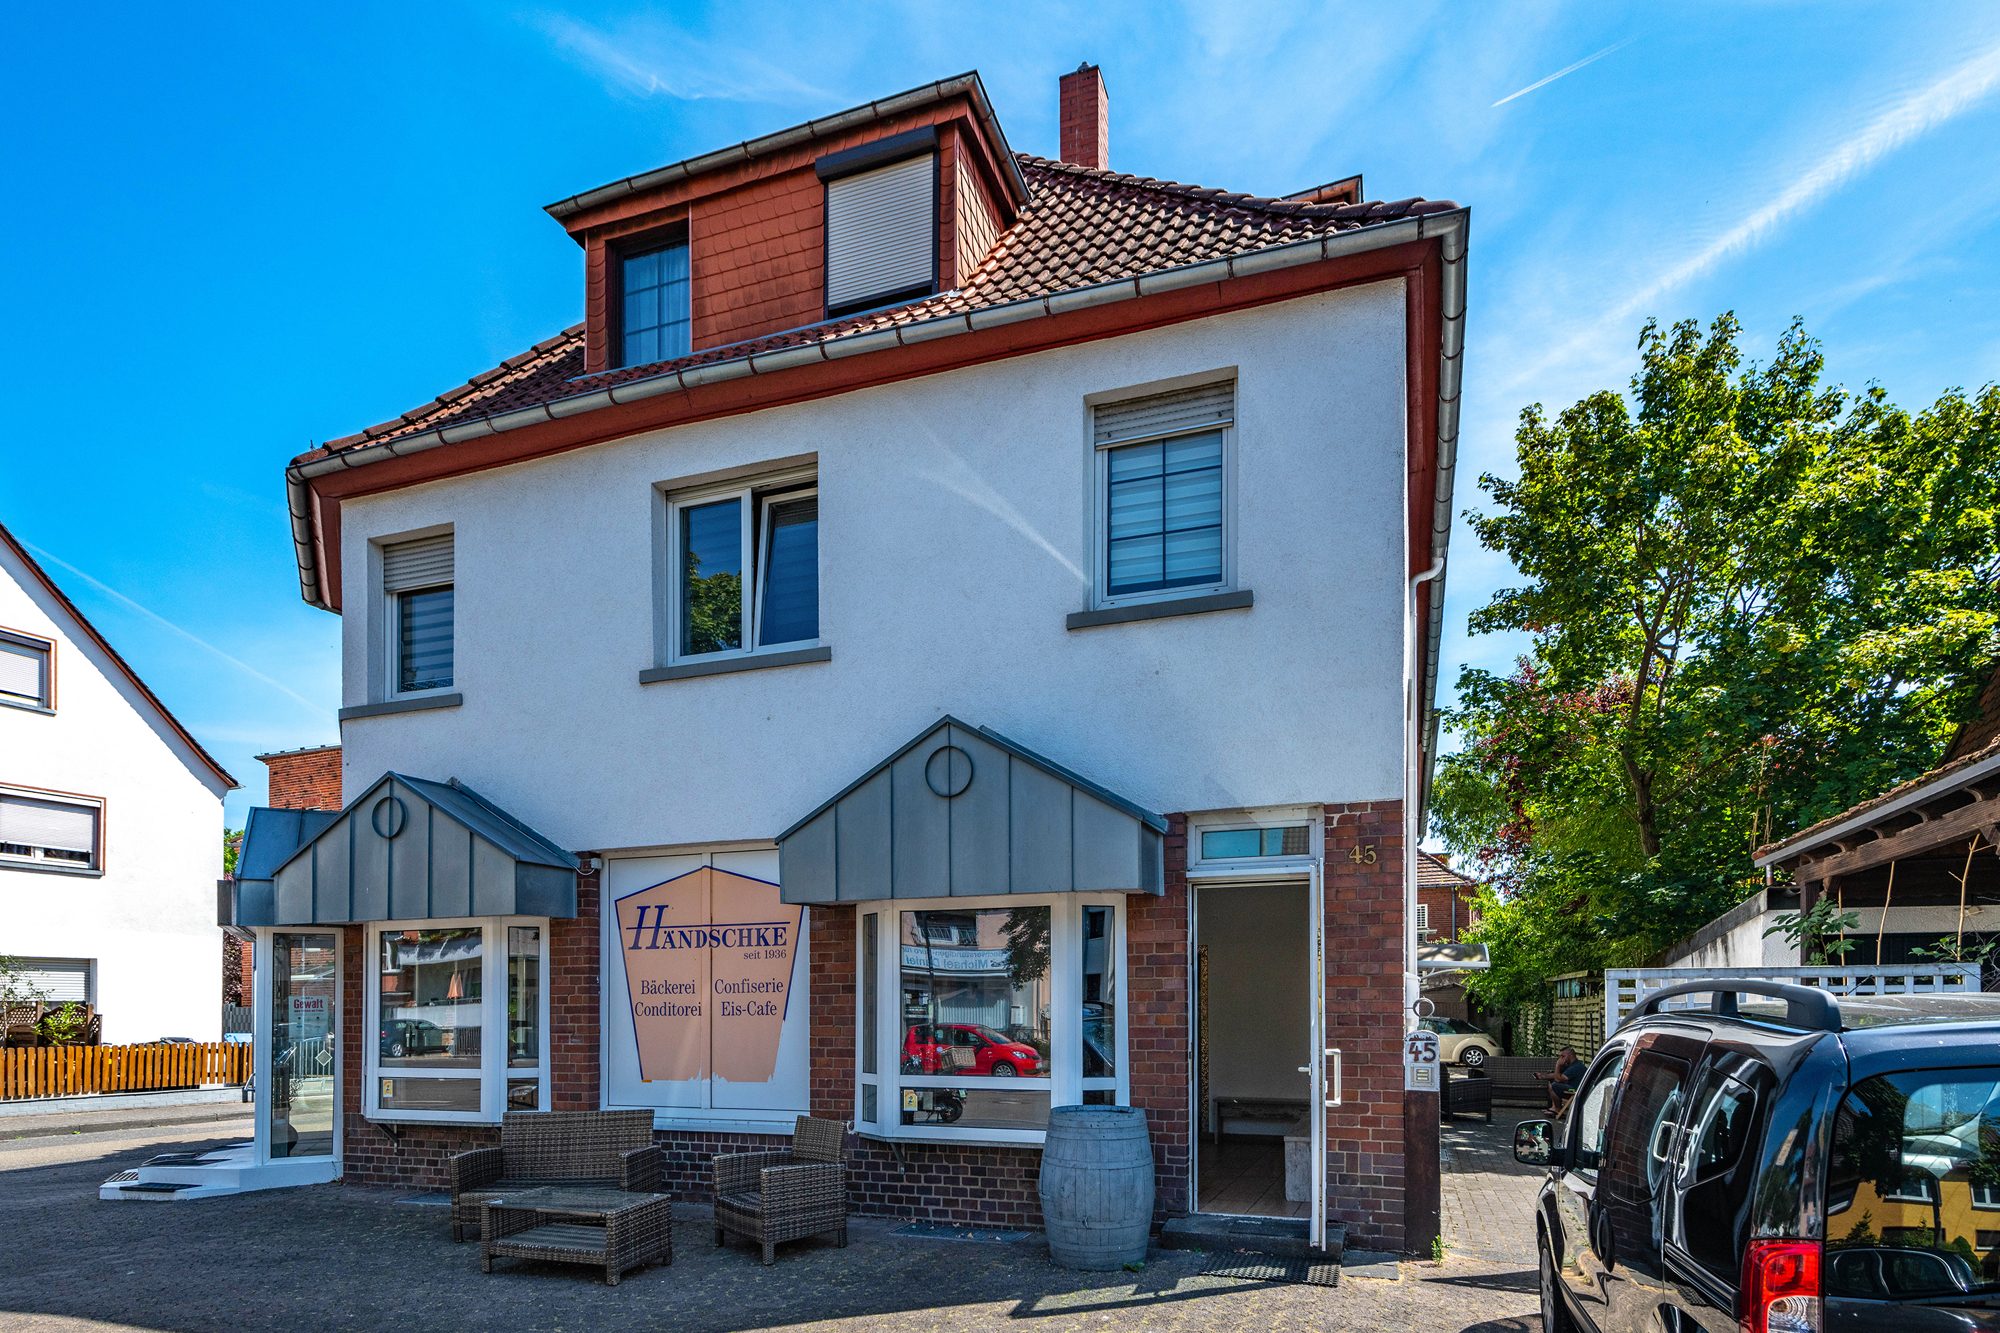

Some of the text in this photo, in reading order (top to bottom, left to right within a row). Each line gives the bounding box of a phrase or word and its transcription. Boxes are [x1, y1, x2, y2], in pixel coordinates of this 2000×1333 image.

[1348, 844, 1377, 865] 45
[627, 904, 788, 950] HÄNDSCHKE
[743, 949, 787, 960] seit 1936
[640, 979, 696, 995] Bäckerei
[714, 978, 784, 995] Confiserie
[293, 999, 324, 1009] Gewalt
[634, 1001, 702, 1017] Conditorei
[721, 1000, 778, 1017] Eis-Cafe
[1408, 1041, 1437, 1062] 45
